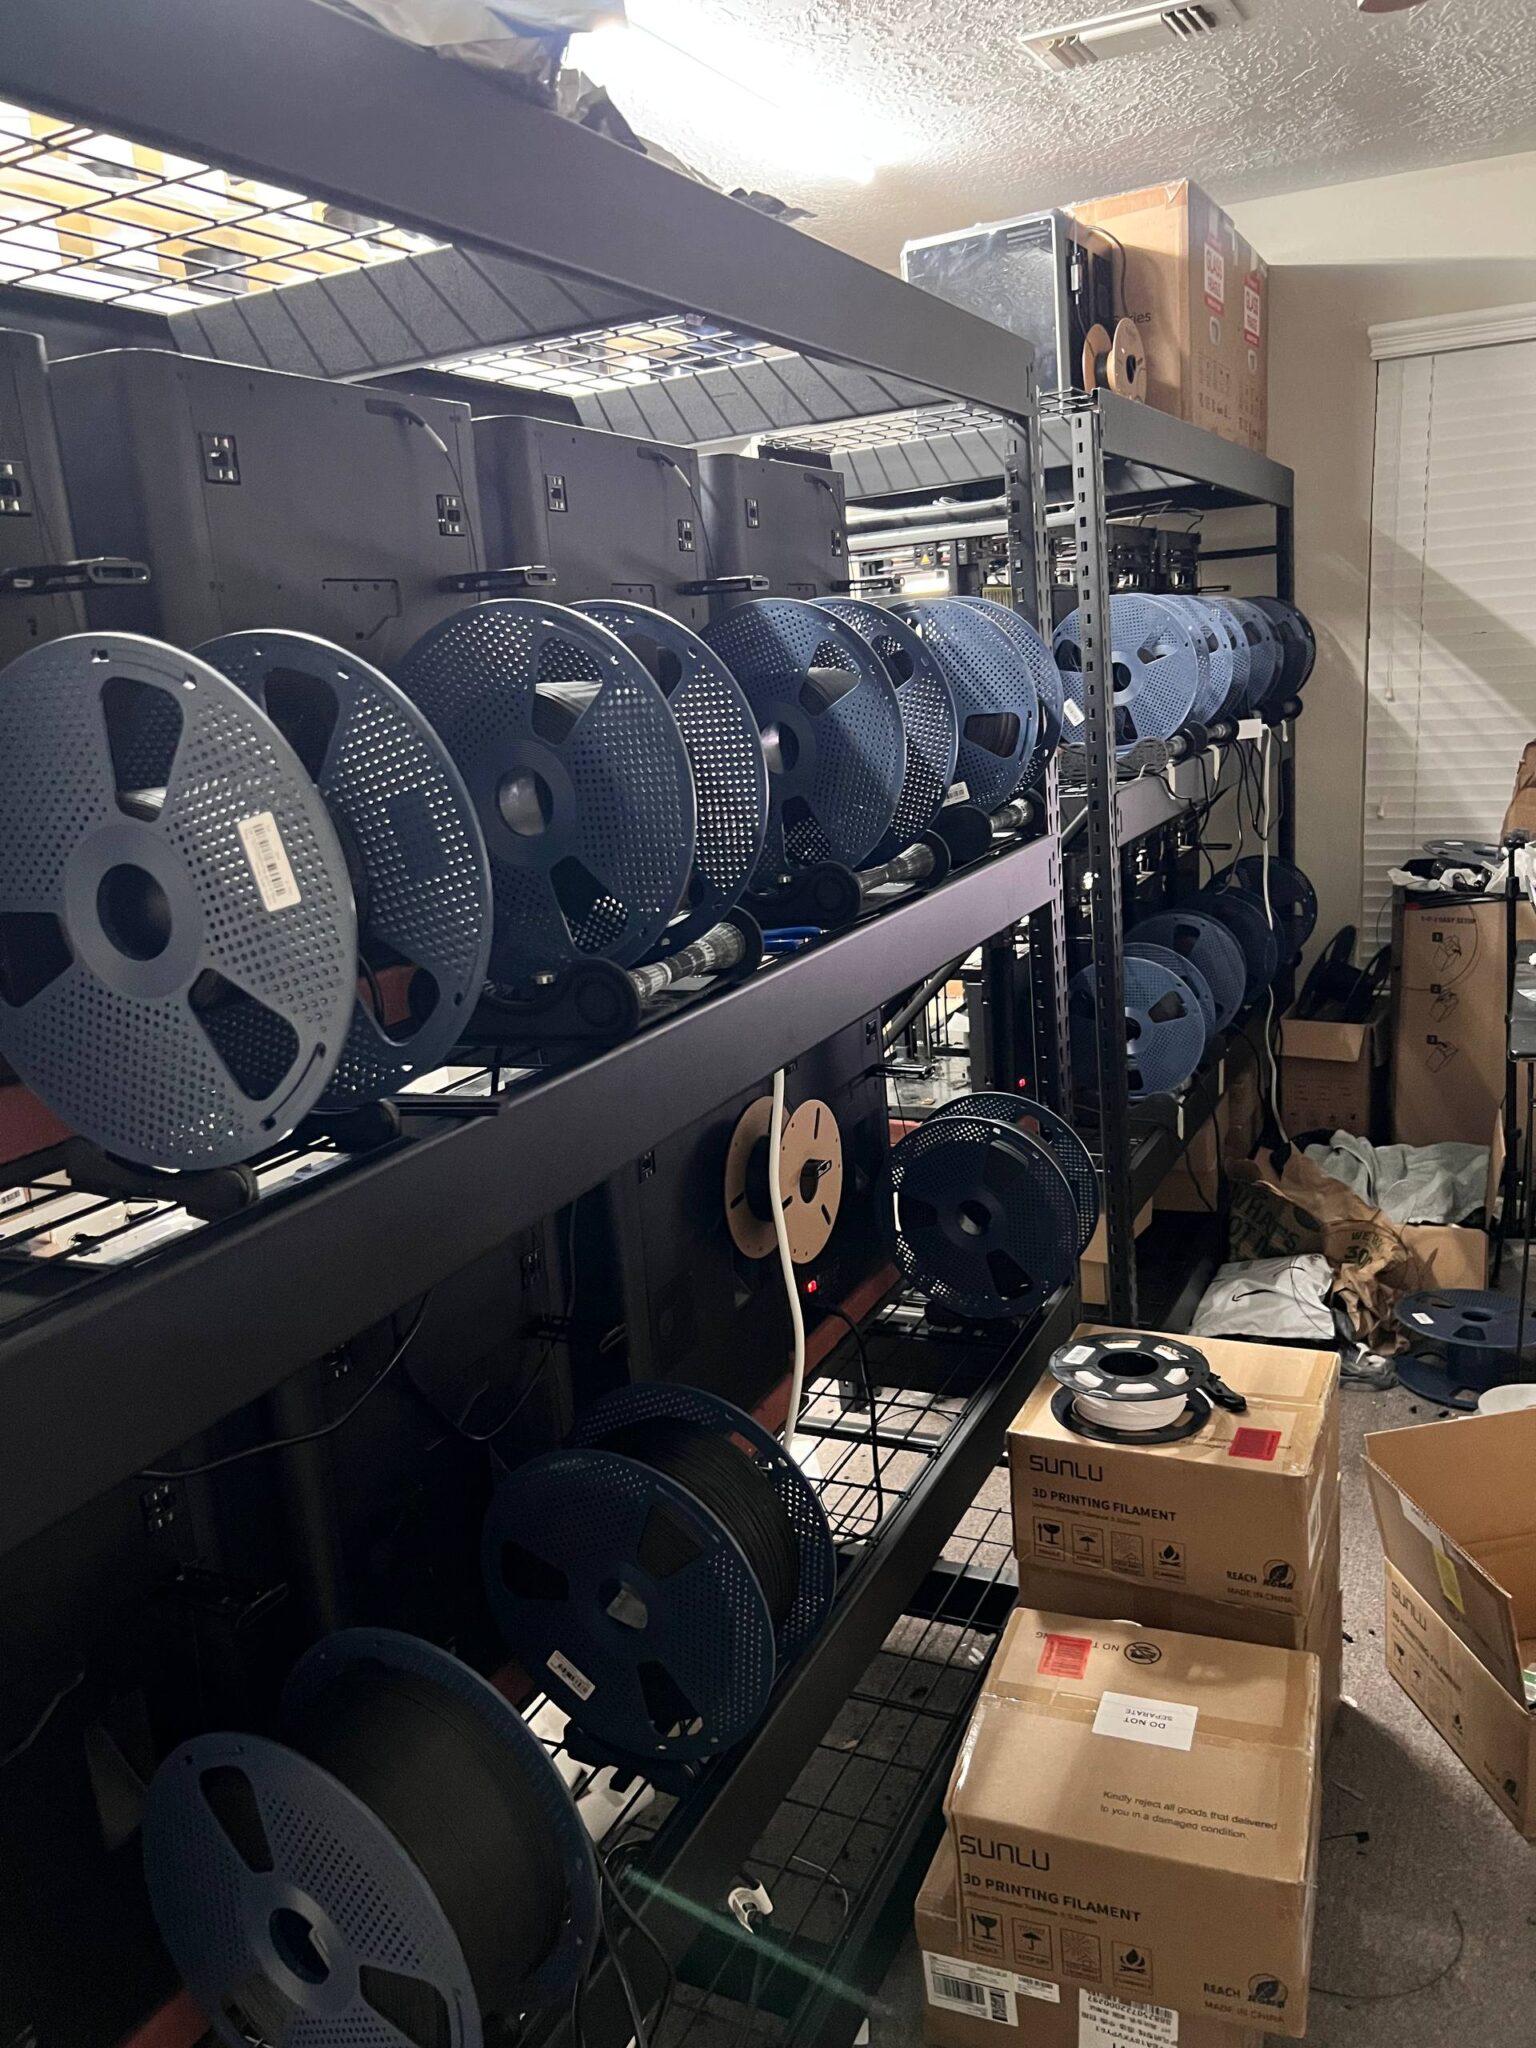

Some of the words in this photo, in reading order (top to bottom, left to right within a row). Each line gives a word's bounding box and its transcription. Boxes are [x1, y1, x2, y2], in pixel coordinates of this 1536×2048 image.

[1029, 1454, 1103, 1482] SUNLU
[1031, 1487, 1047, 1499] 3D
[1050, 1490, 1110, 1511] PRINTING
[1113, 1502, 1176, 1522] FILAMENT
[1226, 1570, 1257, 1584] REACH
[1227, 1587, 1250, 1596] MADE
[1264, 1593, 1293, 1603] CHINA
[1102, 1642, 1120, 1652] NO
[1123, 1717, 1147, 1726] NOT
[1125, 1708, 1173, 1721] SEPARATE
[1149, 1721, 1166, 1729] DO
[1103, 1790, 1132, 1804] Kindly
[1134, 1797, 1161, 1810] reject
[1163, 1803, 1175, 1811] all
[1177, 1805, 1207, 1818] goods
[1210, 1811, 1229, 1821] that
[1231, 1816, 1278, 1831] delivered
[1111, 1807, 1129, 1816] you
[1132, 1811, 1141, 1819] in
[1152, 1814, 1198, 1830] damaged
[1200, 1824, 1249, 1840] condition.
[960, 1834, 1050, 1871] SUNLU
[963, 1873, 981, 1887] 3D
[985, 1878, 1059, 1904] PRINTING
[1063, 1895, 1141, 1922] FILAMENT
[1203, 1982, 1240, 1997] REACH
[1204, 2000, 1232, 2013] MADE
[1237, 2007, 1248, 2016] IN
[1250, 2009, 1285, 2024] CHINA
